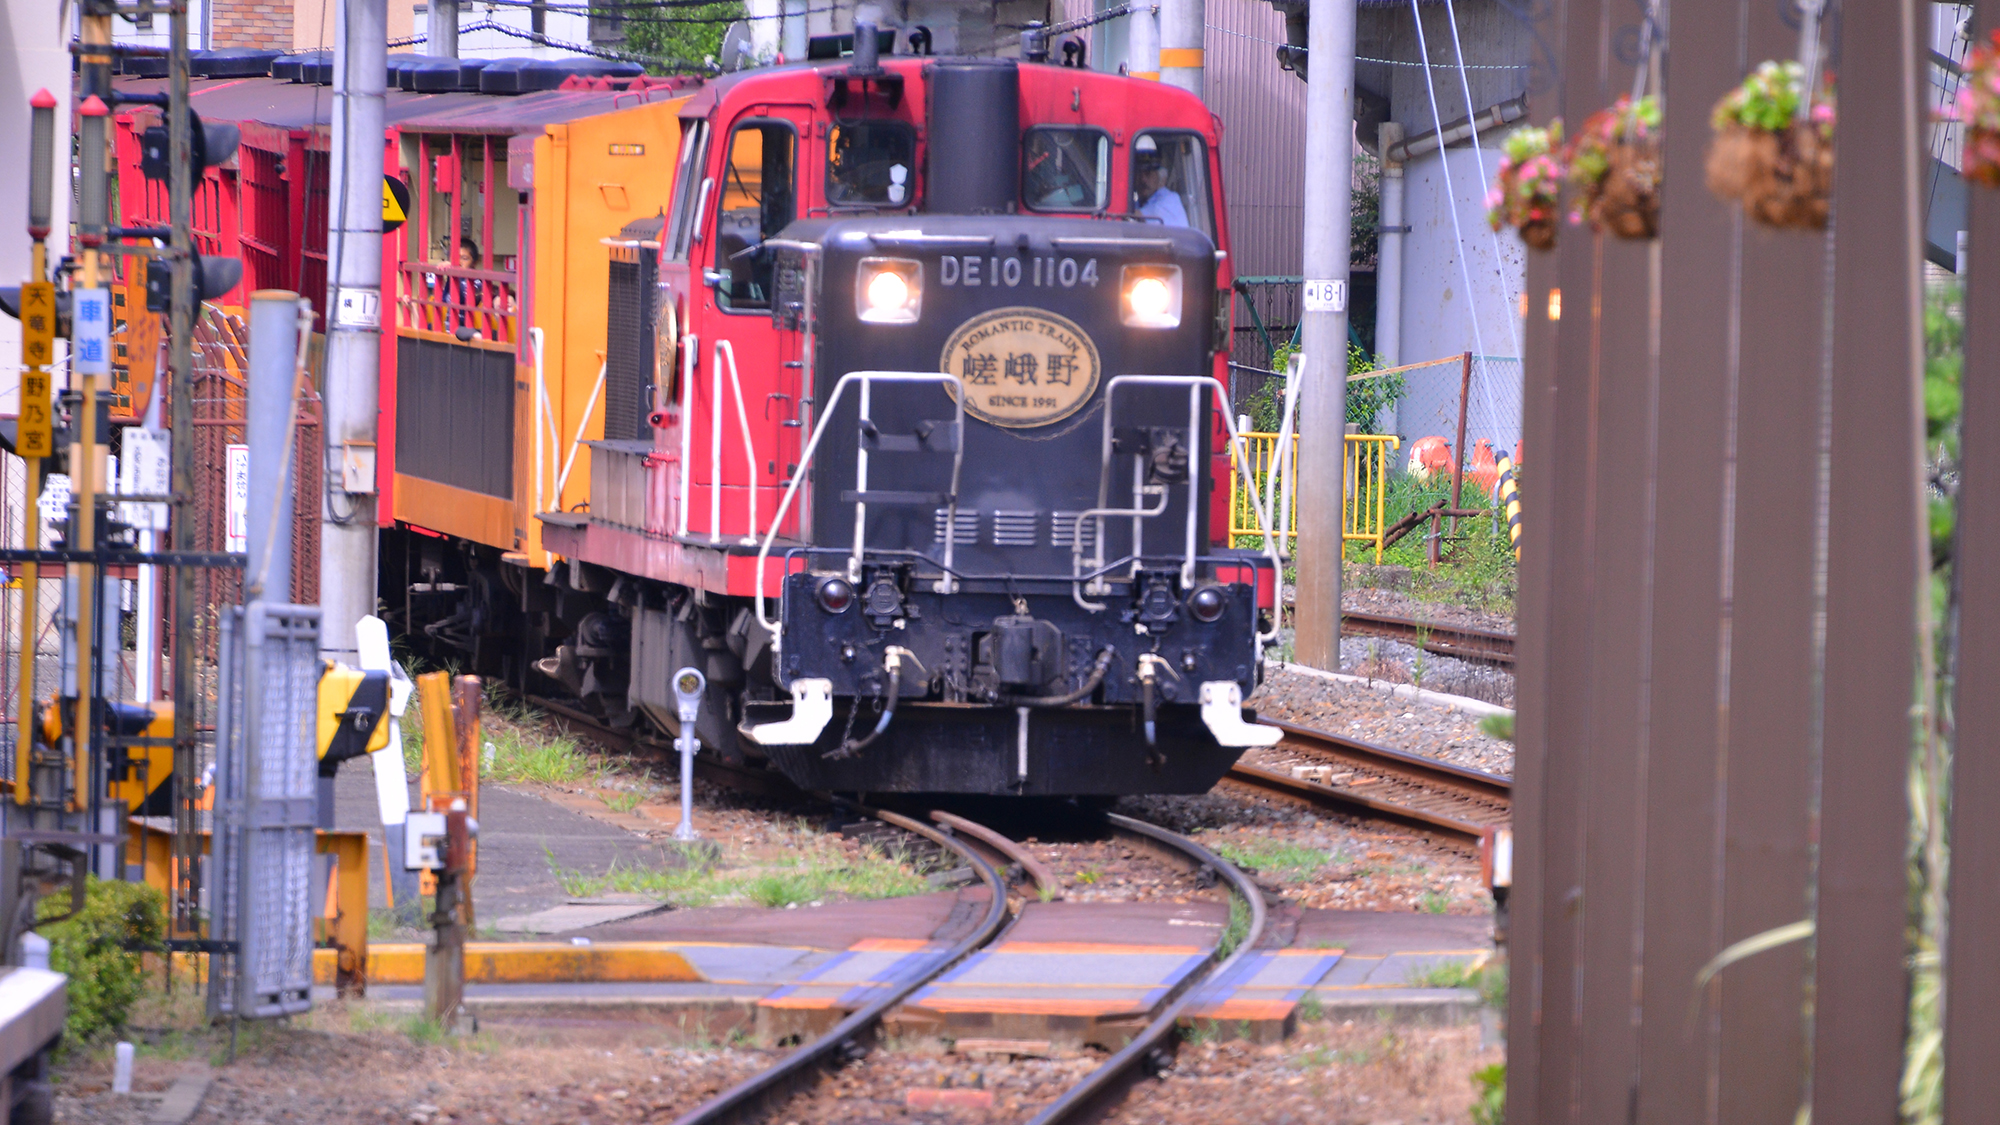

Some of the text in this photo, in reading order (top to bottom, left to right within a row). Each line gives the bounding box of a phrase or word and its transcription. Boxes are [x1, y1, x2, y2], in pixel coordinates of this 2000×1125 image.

[1033, 257, 1100, 288] 1104
[1316, 284, 1342, 302] 18-1
[79, 299, 104, 363] 車道
[961, 320, 1080, 353] ROMANTIC TRAIN
[962, 352, 1080, 387] 嵯峨野
[987, 395, 1058, 408] SINCE 1991
